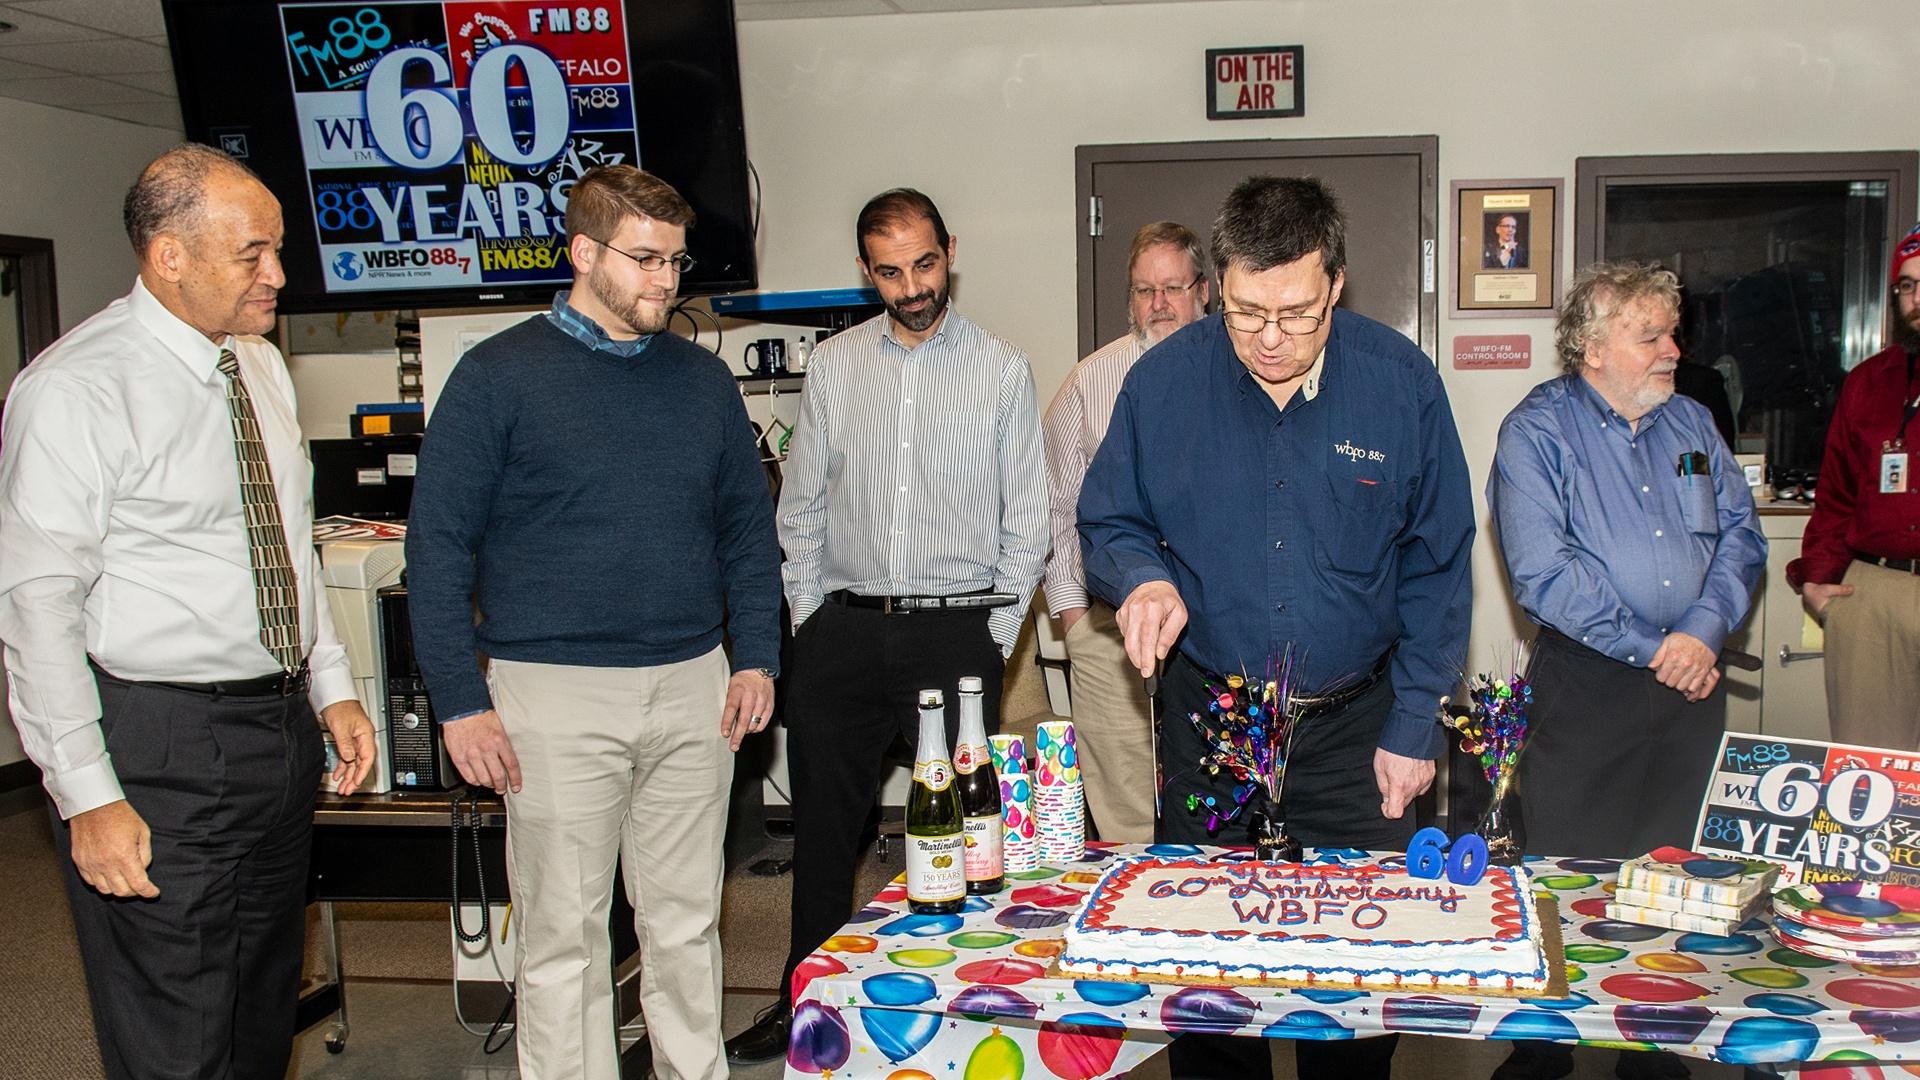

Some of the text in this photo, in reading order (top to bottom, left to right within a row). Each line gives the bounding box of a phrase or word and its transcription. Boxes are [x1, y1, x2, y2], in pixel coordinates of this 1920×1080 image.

[528, 7, 610, 33] FM88
[287, 8, 392, 87] FM88
[1217, 54, 1293, 83] ON THE
[365, 44, 570, 170] 60
[570, 88, 619, 117] FM88
[1236, 83, 1275, 112] AIR
[1456, 352, 1495, 360] CONTROL
[1497, 352, 1521, 360] ROOM
[1334, 440, 1366, 462] wbfo
[1726, 743, 1791, 771] FM88
[1758, 762, 1895, 828] 60
[1406, 827, 1490, 886] 60
[1738, 818, 1892, 875] YEARS
[923, 871, 961, 881] 150 YEARS
[1232, 899, 1388, 929] WBFO
